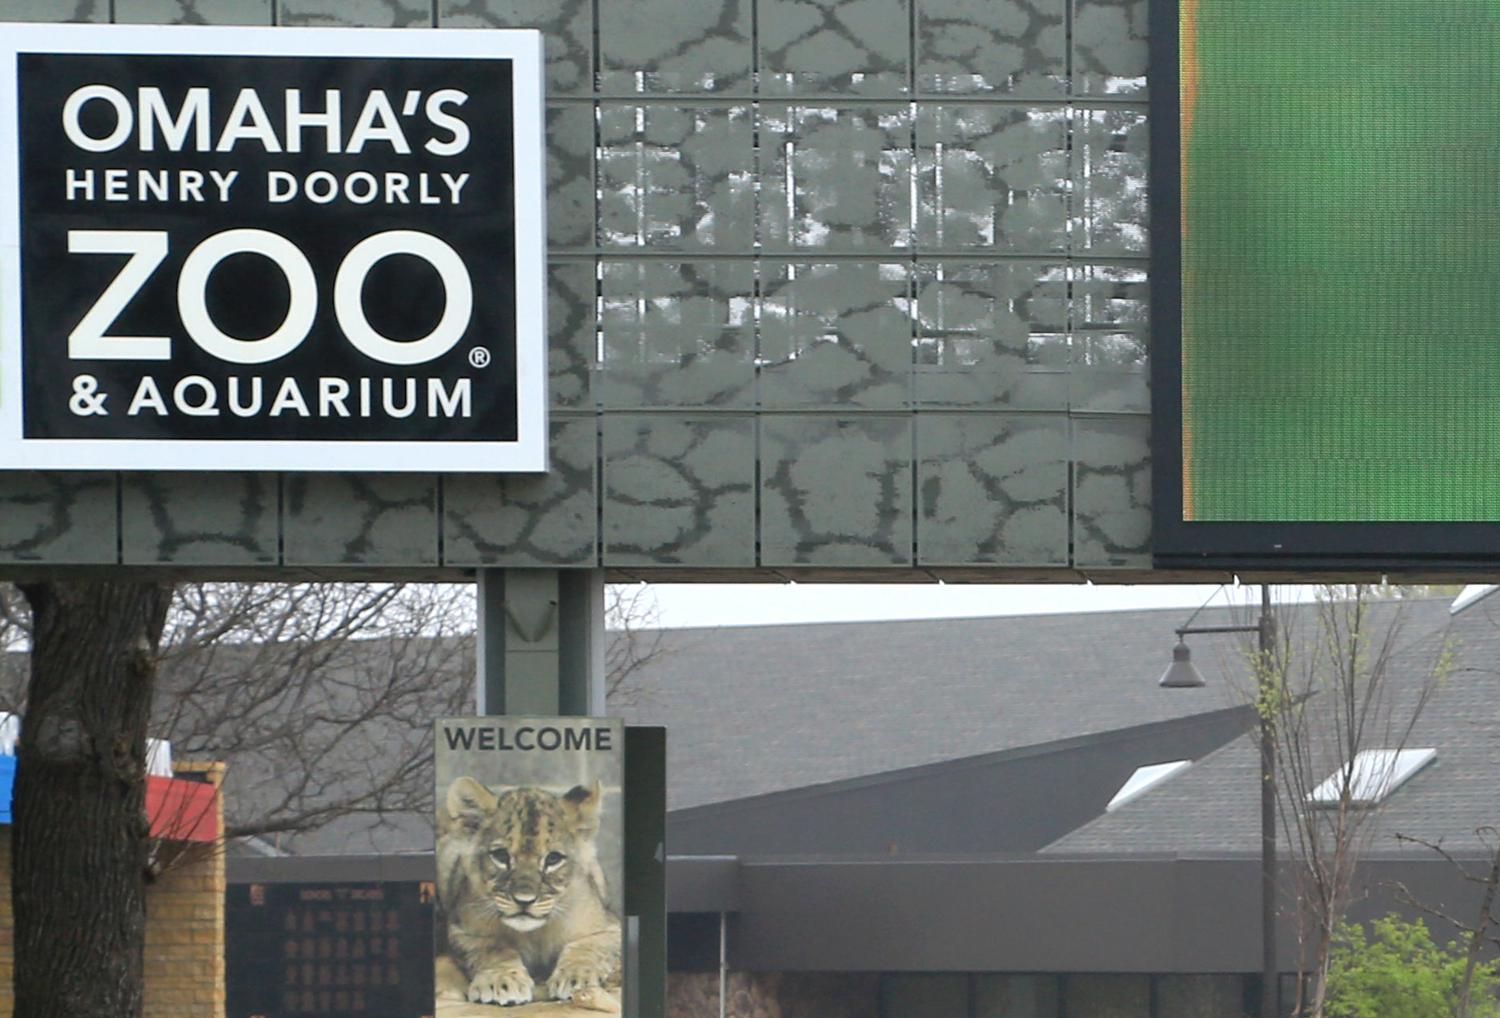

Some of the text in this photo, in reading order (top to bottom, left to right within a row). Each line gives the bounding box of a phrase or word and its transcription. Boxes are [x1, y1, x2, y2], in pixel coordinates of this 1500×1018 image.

[62, 84, 471, 157] OMAHA'S
[66, 169, 470, 204] HENRY DOORLY
[69, 375, 472, 418] & AQUARIUM
[444, 727, 612, 751] WELCOME
